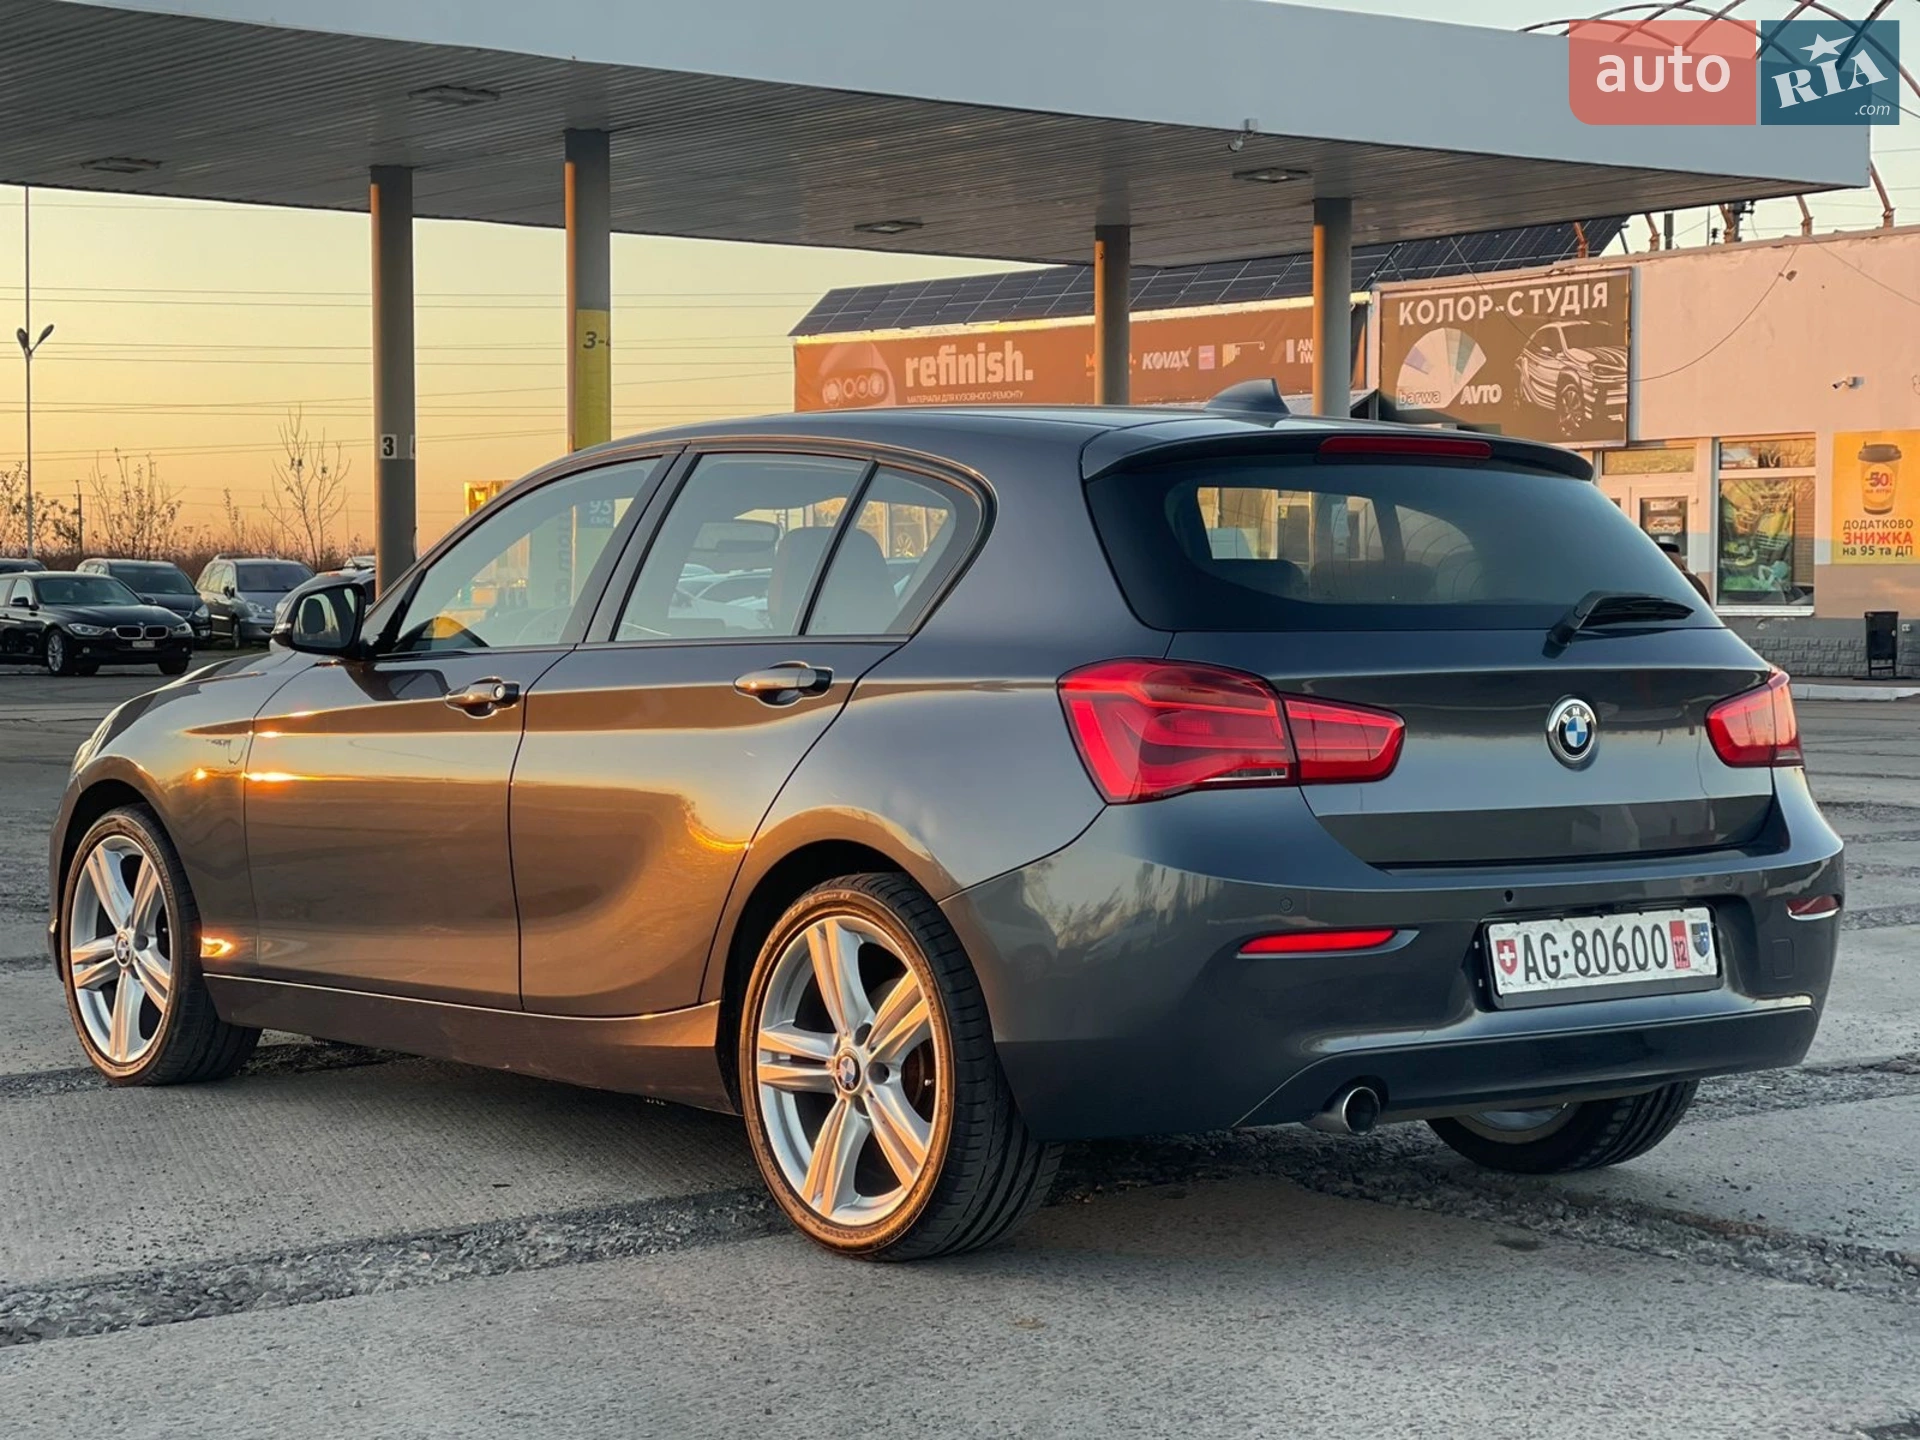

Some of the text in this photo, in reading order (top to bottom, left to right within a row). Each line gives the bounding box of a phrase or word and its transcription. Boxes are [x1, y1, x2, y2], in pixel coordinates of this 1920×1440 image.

[905, 340, 1034, 388] refinish.
[1142, 346, 1192, 371] KOVAX
[992, 389, 1024, 400] РЕМОНТУ
[1399, 389, 1441, 405] barwa
[1460, 383, 1502, 405] AVTO
[383, 436, 394, 456] 3
[1843, 519, 1913, 530] ДОДАТКОВО
[1843, 532, 1913, 545] ЗНИЖКА
[1860, 546, 1875, 555] 95
[1879, 547, 1891, 555] та
[1895, 546, 1913, 557] ДП
[1674, 940, 1687, 962] 12
